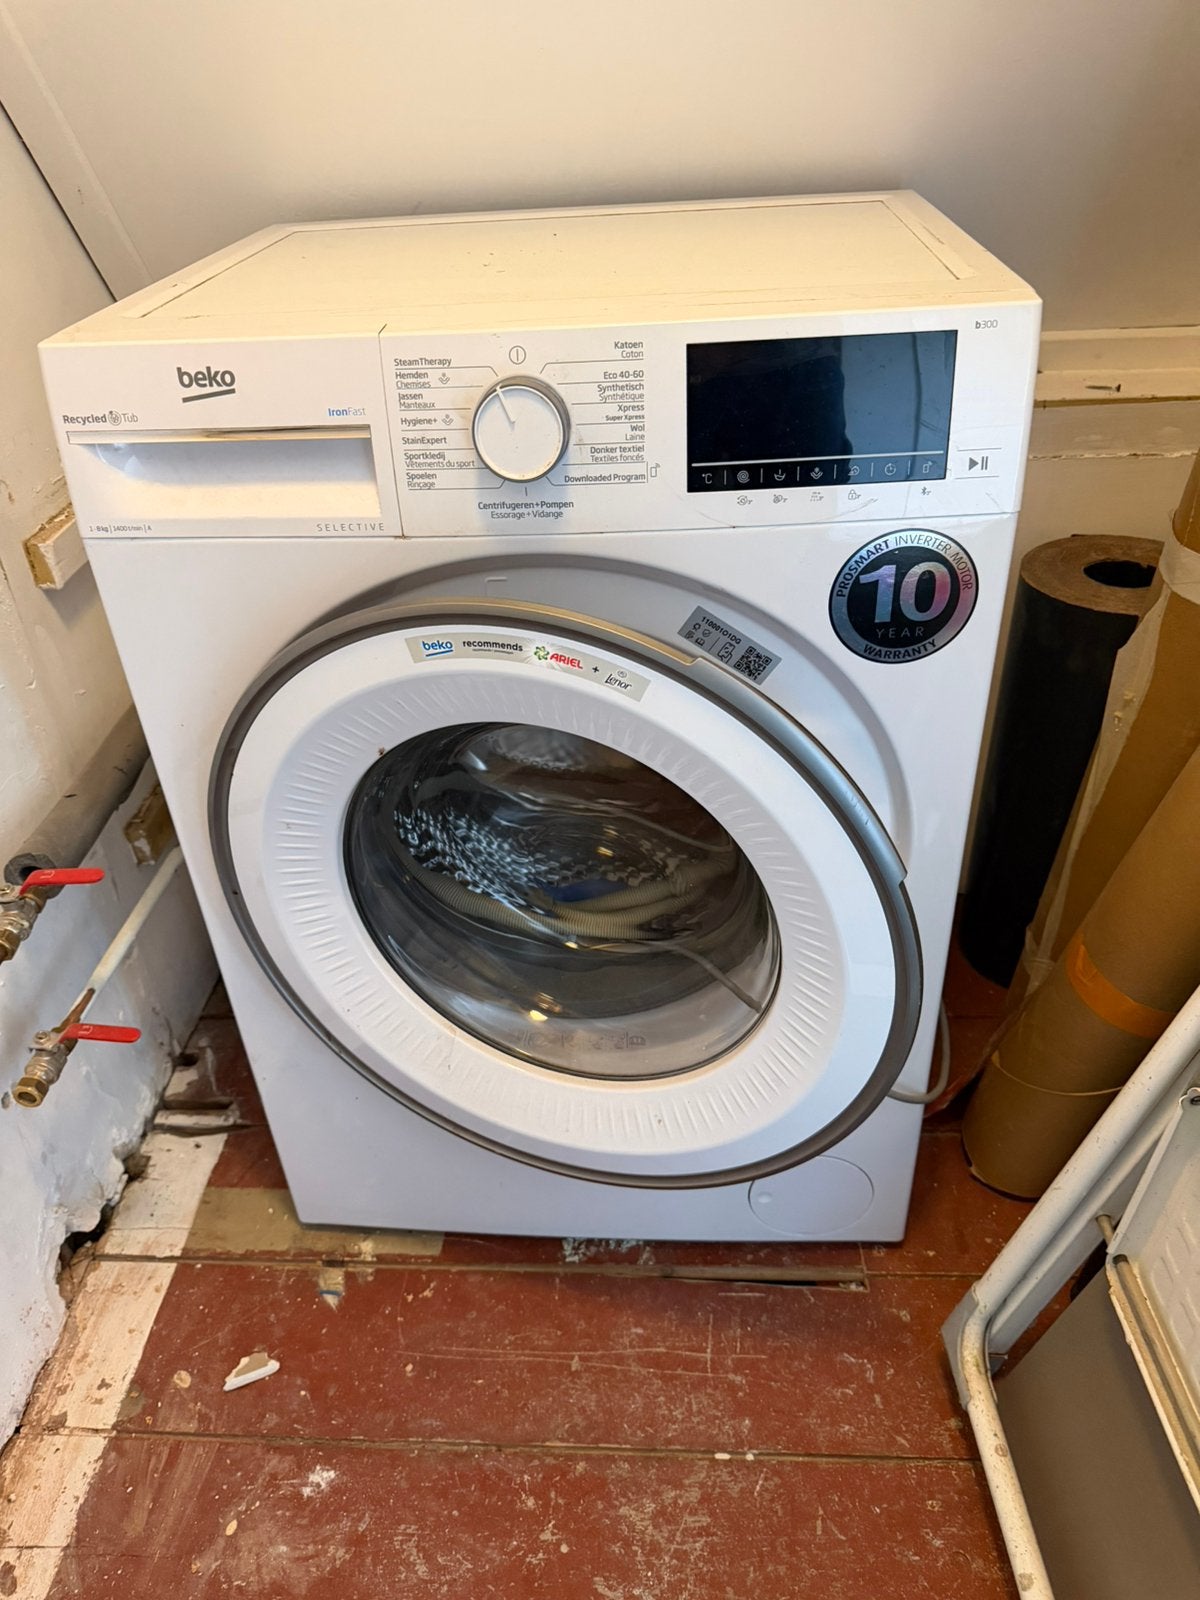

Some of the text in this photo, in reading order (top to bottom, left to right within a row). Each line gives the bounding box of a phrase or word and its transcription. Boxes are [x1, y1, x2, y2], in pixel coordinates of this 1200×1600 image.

[975, 319, 998, 329] b300
[614, 341, 644, 350] Katoen
[621, 350, 644, 358] Coton
[394, 358, 452, 367] SteamTherapy
[176, 366, 236, 388] beko
[395, 372, 428, 380] Hemden
[603, 370, 644, 380] Eco 40-60
[396, 380, 431, 389] Chemises
[597, 383, 644, 393] Synthetisch
[599, 392, 645, 403] Synthétique
[399, 401, 435, 409] Manteaux
[617, 404, 645, 412] Xpress
[328, 407, 366, 416] IronFast
[62, 413, 139, 426] Recycled Tub
[401, 417, 437, 427] Hygiene+
[624, 414, 645, 422] Xpress
[630, 423, 645, 432] Wol
[402, 437, 447, 446] StainExpert
[625, 433, 645, 441] Laine
[590, 444, 645, 454] Donker textiel
[404, 452, 446, 461] Sportkledij
[590, 453, 644, 463] Textiles foncés
[405, 460, 475, 469] Vêtements du sport
[406, 472, 437, 481] Spoelen
[564, 473, 646, 483] Downloaded Program
[407, 481, 436, 490] Rinçage
[316, 523, 385, 532] SELECTIVE
[836, 534, 973, 598] PROSMART INVERTER MOTOR
[859, 561, 952, 624] 10
[876, 626, 925, 639] YEAR
[863, 639, 937, 660] WARRANTY
[422, 640, 453, 651] beko
[462, 641, 523, 652] recommends
[549, 652, 584, 670] ARIEL
[604, 672, 632, 691] Lenor
